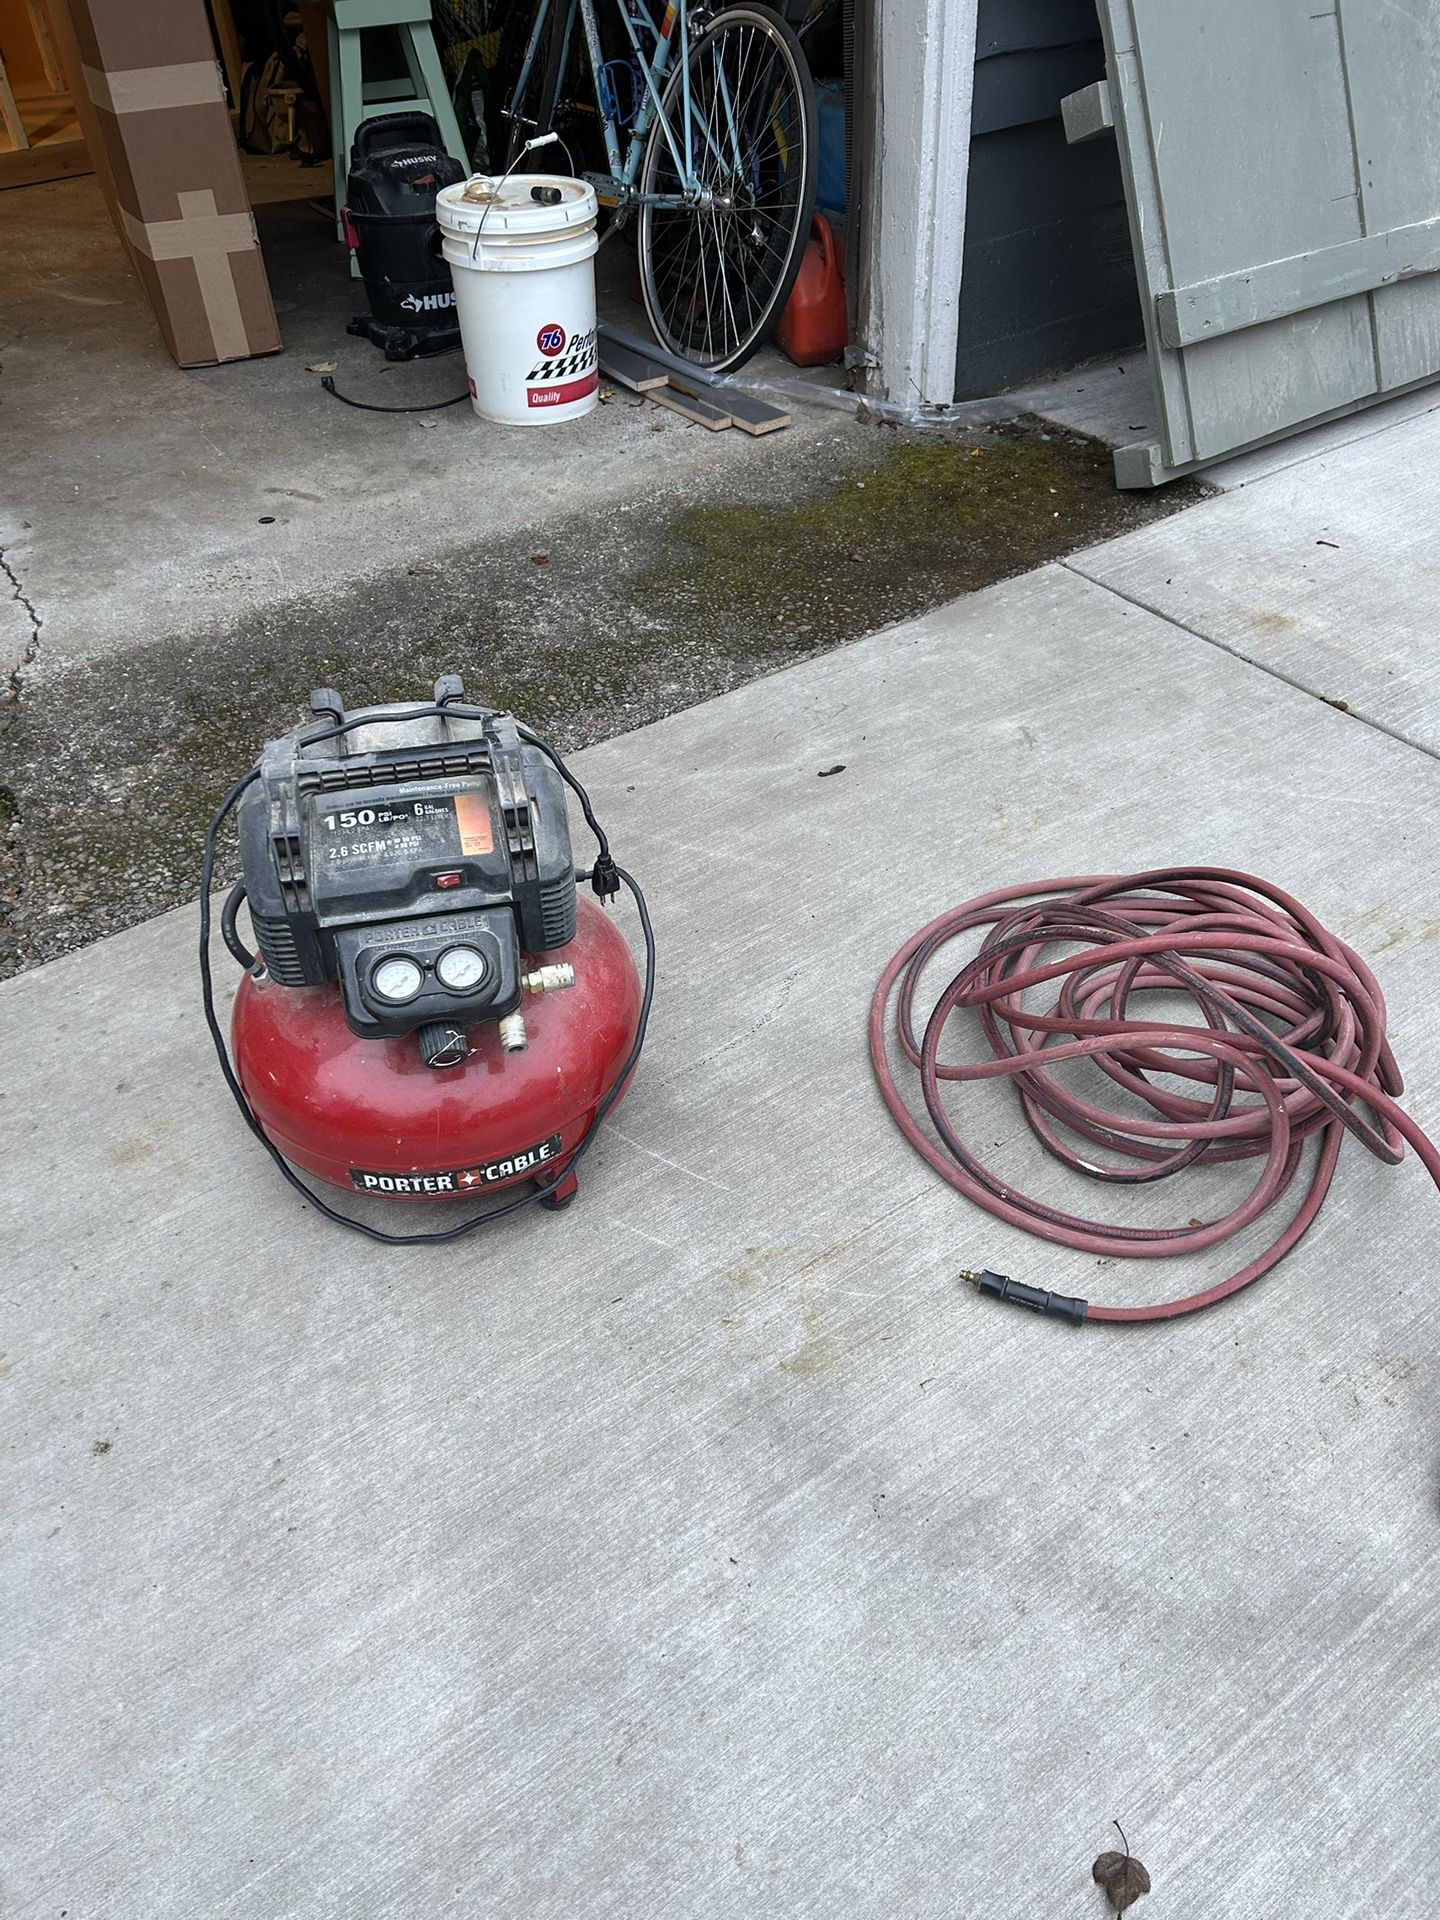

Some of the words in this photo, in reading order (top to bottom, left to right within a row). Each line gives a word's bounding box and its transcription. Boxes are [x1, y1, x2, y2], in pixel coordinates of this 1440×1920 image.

[402, 155, 437, 165] HUSKY
[541, 328, 562, 350] 76
[532, 392, 560, 403] Quality
[399, 782, 461, 794] Maintenance-Free
[414, 803, 424, 816] 6
[323, 809, 376, 830] 150
[329, 846, 348, 859] 2.6
[363, 1173, 453, 1192] PORTER
[485, 1143, 552, 1180] CABLE
